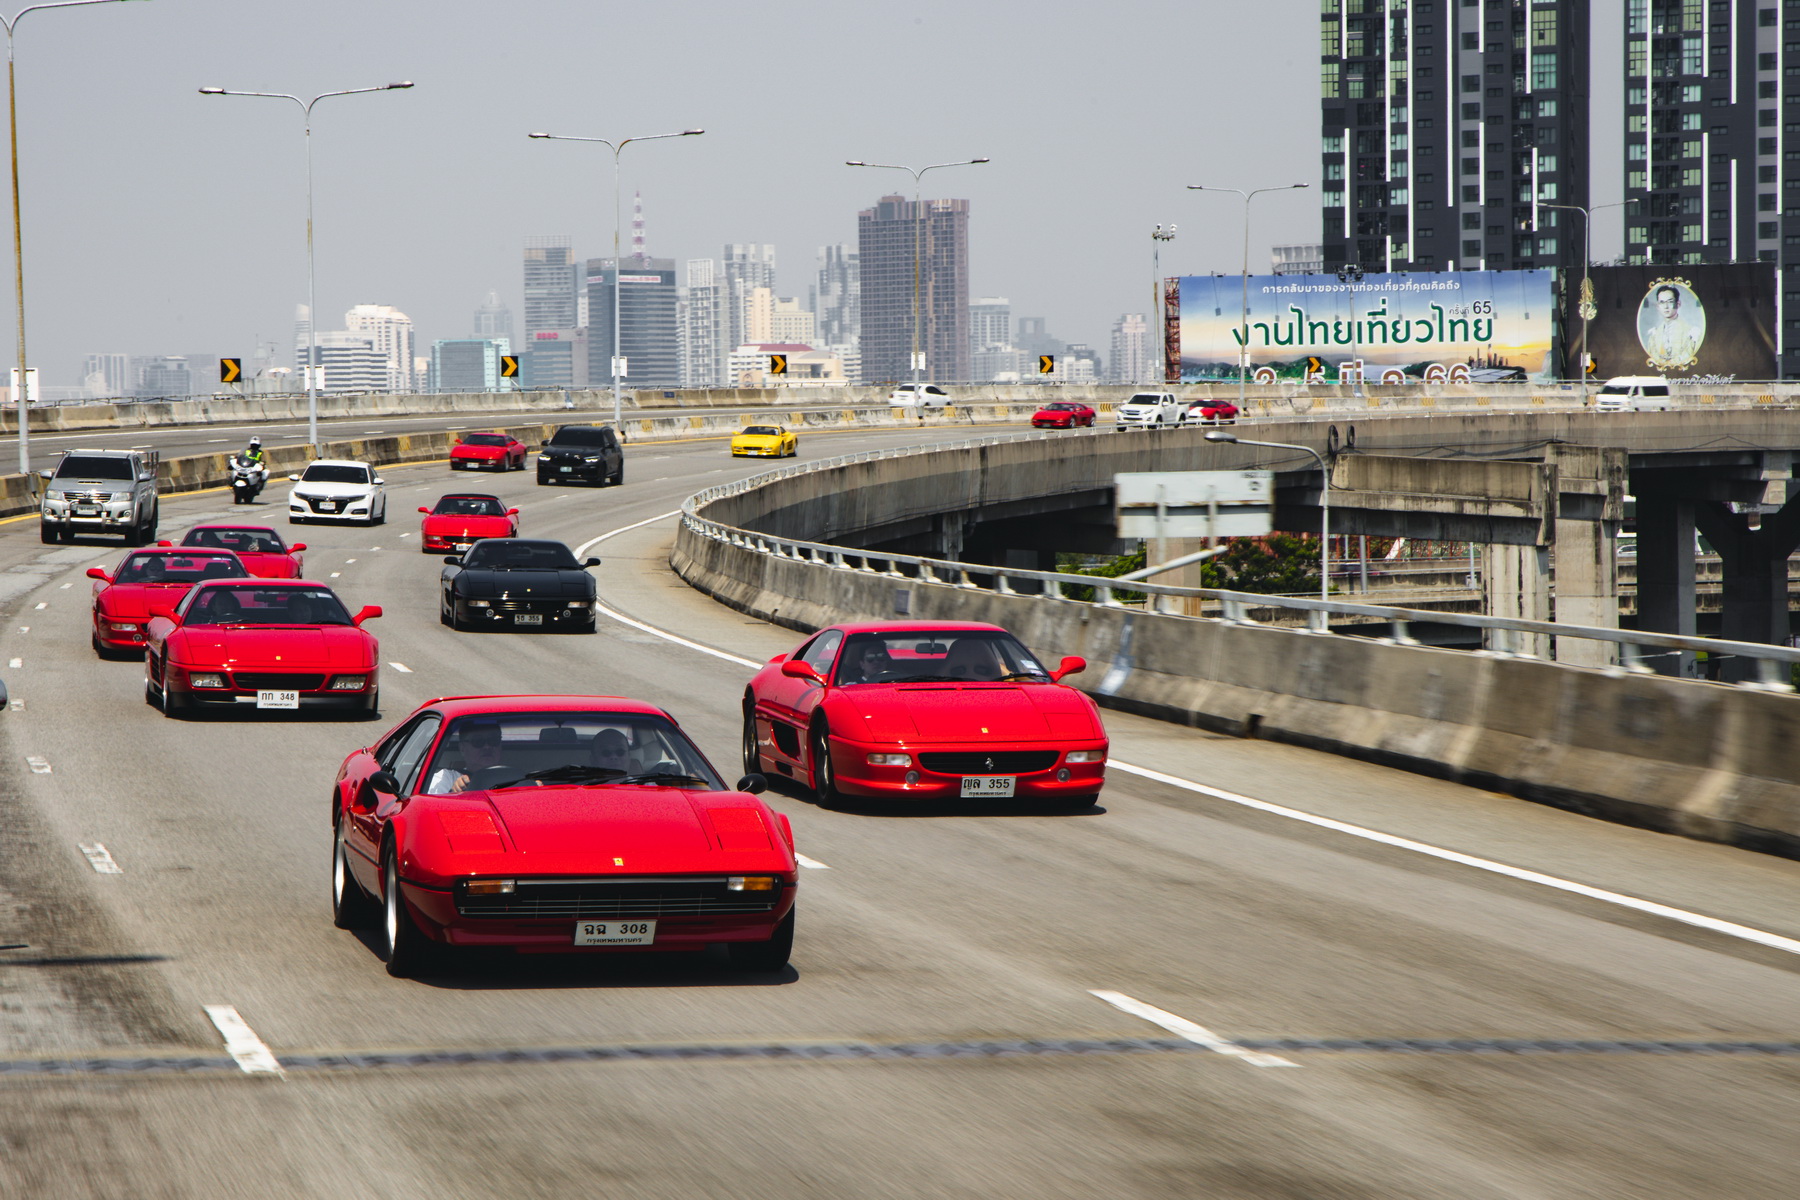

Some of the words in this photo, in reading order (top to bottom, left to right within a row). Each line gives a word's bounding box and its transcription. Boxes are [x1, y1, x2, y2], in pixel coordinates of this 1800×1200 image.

[1472, 300, 1492, 315] 65
[1231, 297, 1493, 346] งานไทยเที่ยวไทย
[280, 692, 295, 701] 348
[988, 778, 1010, 789] 355
[620, 923, 648, 935] 308
